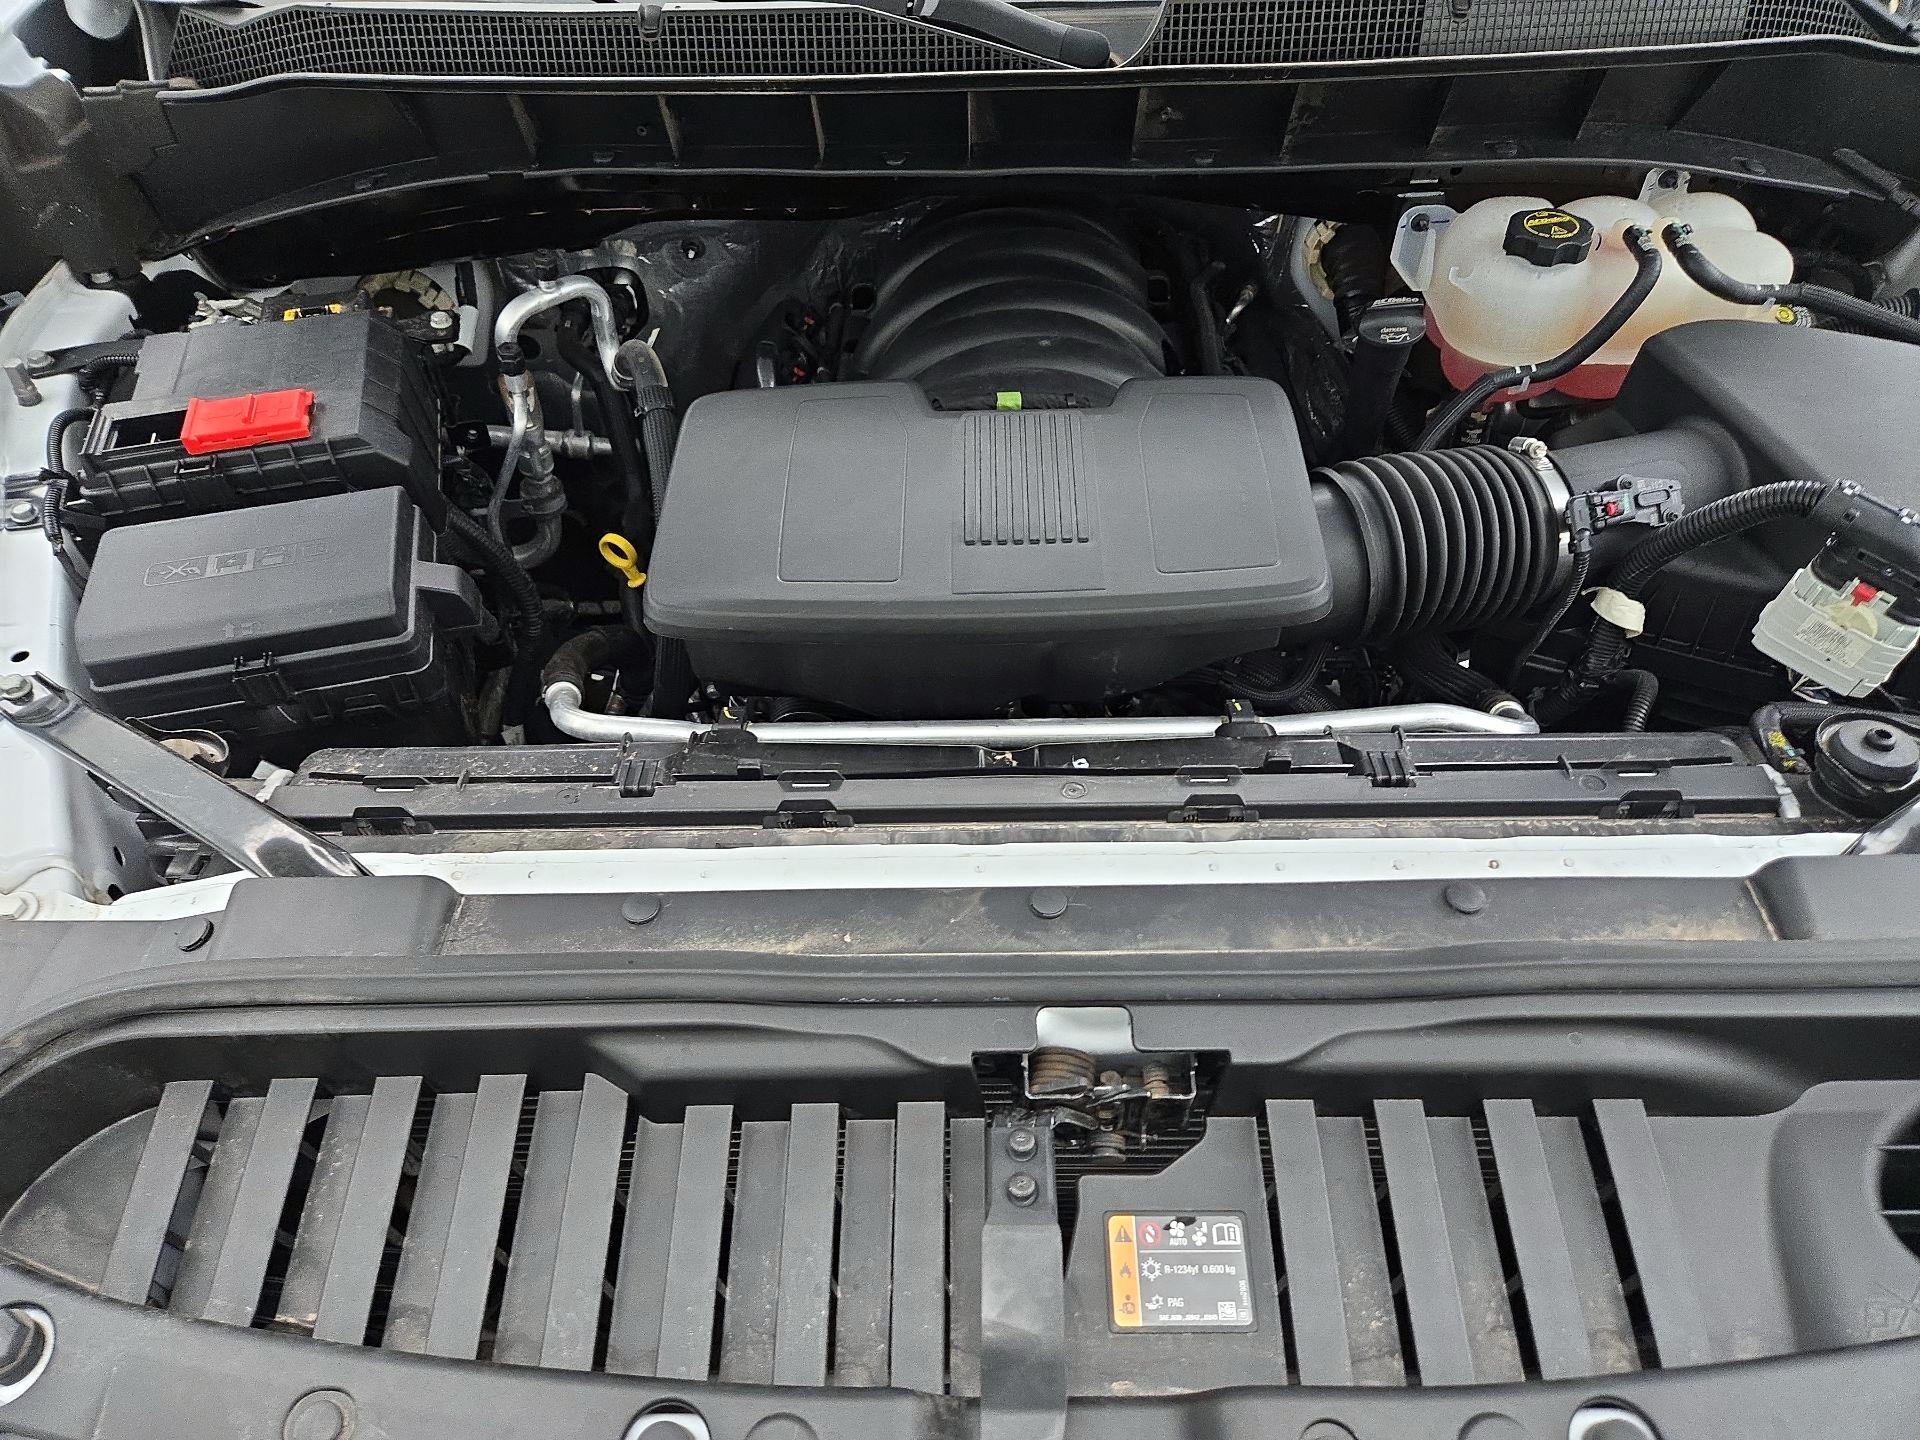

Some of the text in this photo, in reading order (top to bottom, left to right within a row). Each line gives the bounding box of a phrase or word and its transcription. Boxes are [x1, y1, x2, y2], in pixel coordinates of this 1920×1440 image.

[1169, 1237, 1187, 1246] AUTO
[1164, 1264, 1199, 1276] R-1234yf
[1224, 1264, 1236, 1275] kg
[1167, 1297, 1184, 1308] PAG
